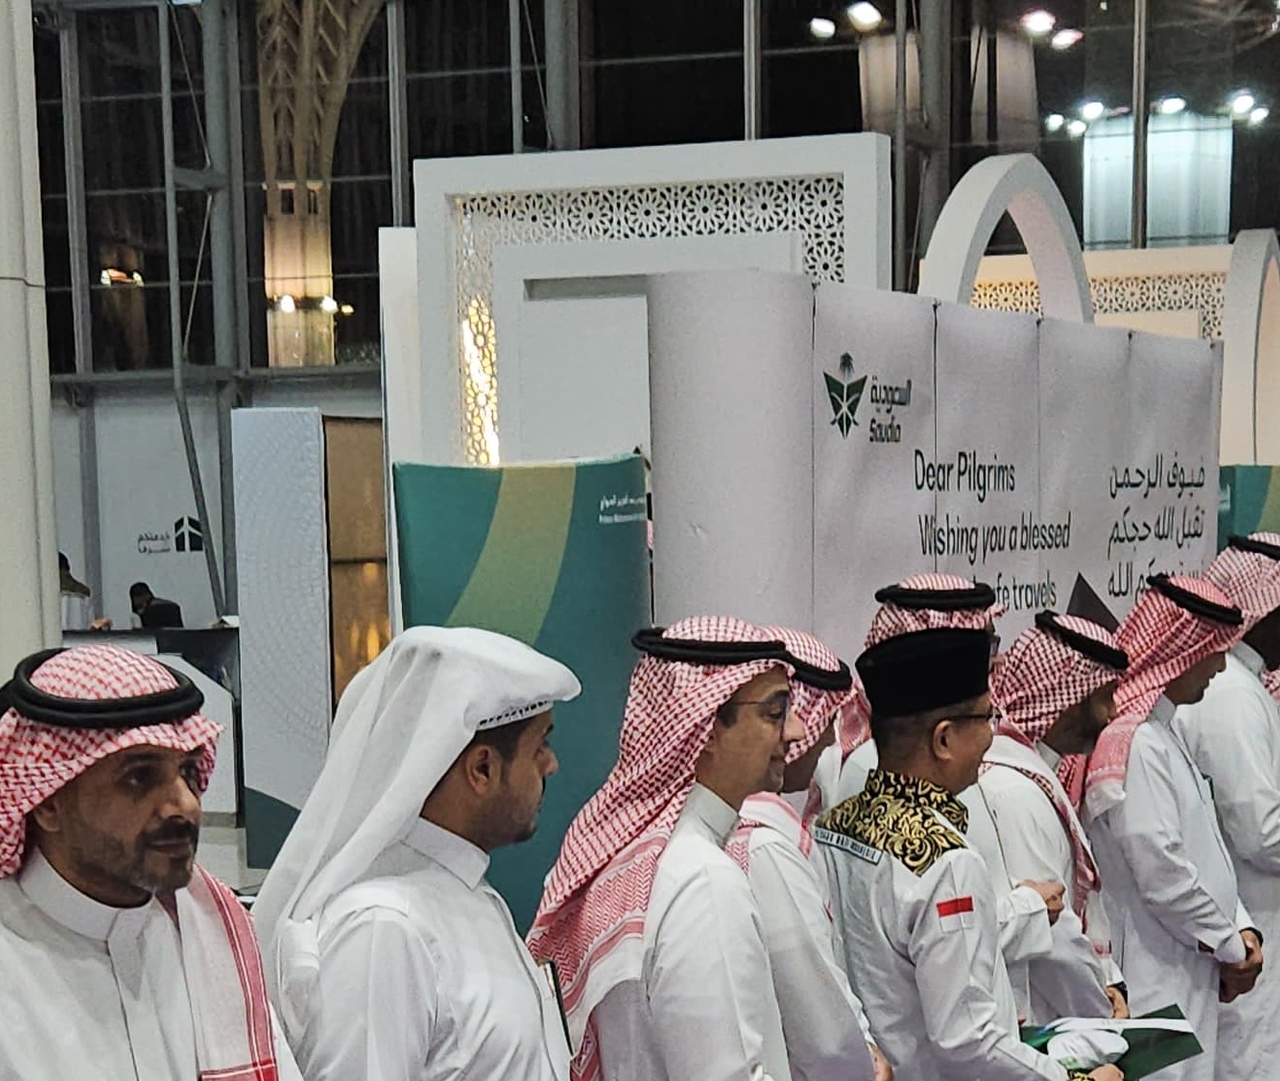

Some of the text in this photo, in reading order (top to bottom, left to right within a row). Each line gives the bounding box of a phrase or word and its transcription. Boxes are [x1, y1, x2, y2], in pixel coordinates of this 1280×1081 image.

[914, 449, 1015, 503] Dear Pilgrims
[1109, 451, 1205, 499] ضيوف الرحمن
[918, 510, 1071, 566] Wishing you a blessed
[1107, 505, 1205, 561] تقبل الله حجكم
[1012, 569, 1057, 611] travels
[1108, 561, 1133, 597] الله
